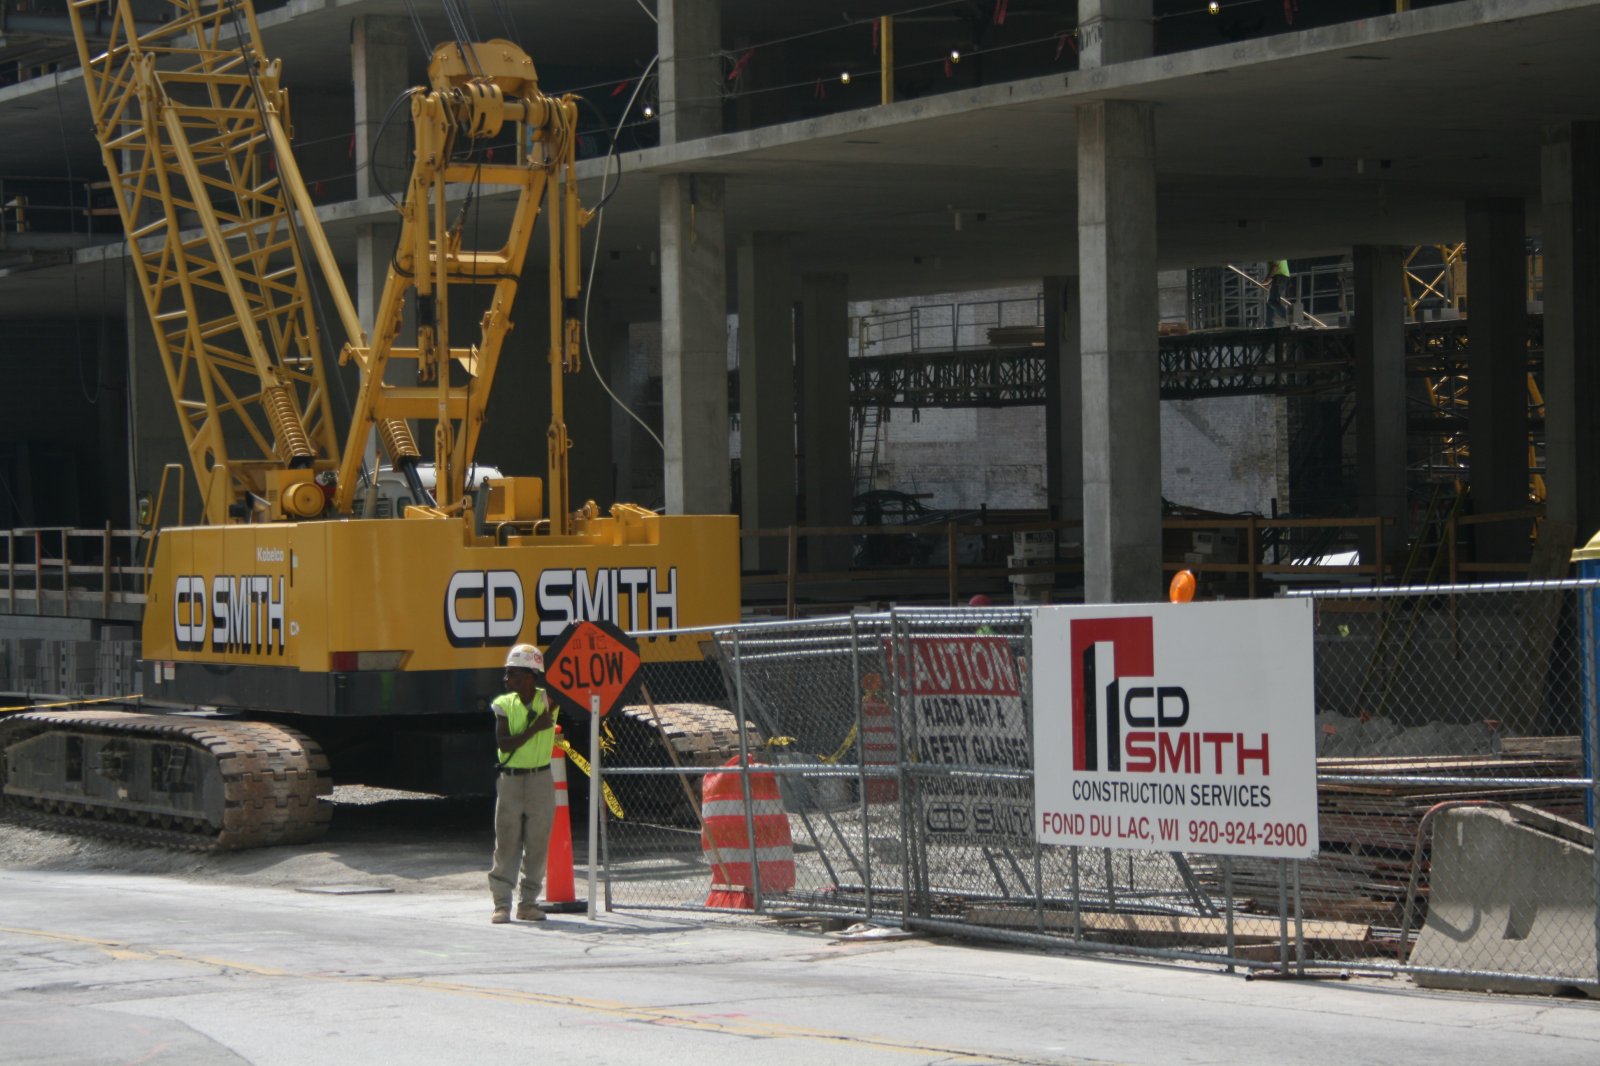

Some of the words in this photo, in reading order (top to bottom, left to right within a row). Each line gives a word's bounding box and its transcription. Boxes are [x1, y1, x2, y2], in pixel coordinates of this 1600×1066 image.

[175, 575, 207, 647] CD
[212, 575, 285, 651] SMITH
[446, 570, 524, 643] CD
[538, 567, 678, 639] SMITH
[559, 651, 623, 690] SLOW
[921, 698, 965, 727] HARD
[964, 698, 994, 728] HAT
[1124, 686, 1190, 728] CD
[972, 735, 1031, 769] GLASSES
[1125, 732, 1270, 776] SMITH
[1072, 780, 1186, 806] CONSTRUCTION
[1190, 784, 1272, 808] SERVICES
[927, 802, 967, 832] CD
[1042, 812, 1086, 836] FOND
[1089, 814, 1113, 837] DU
[1117, 816, 1155, 845] LAC,
[1158, 818, 1180, 841] WI
[1189, 820, 1308, 847] 920-924-2900
